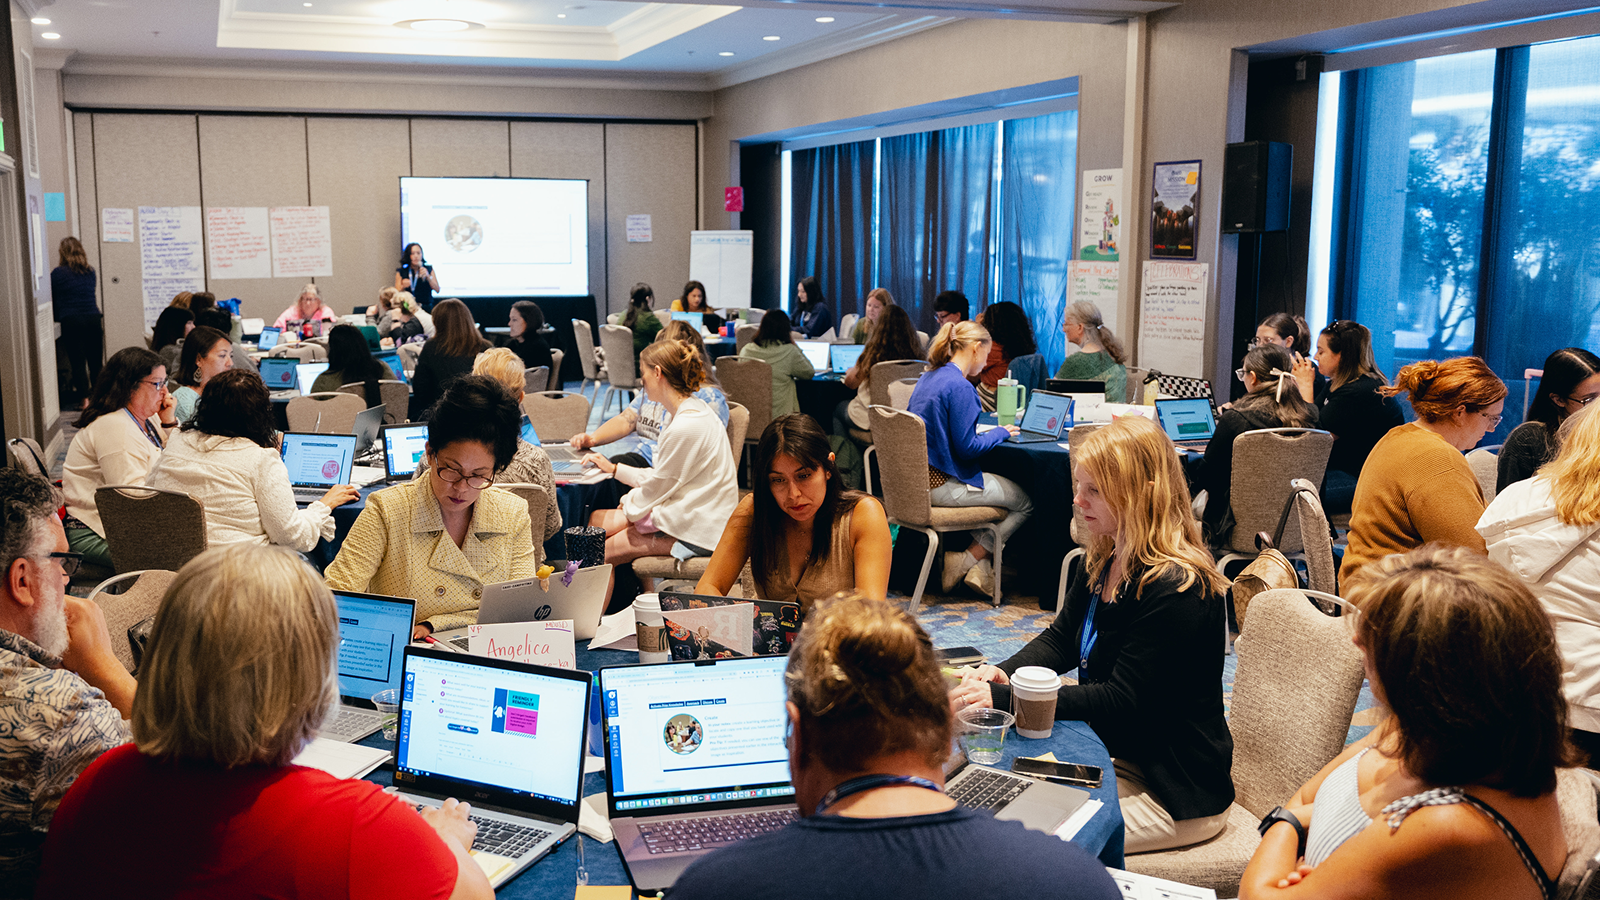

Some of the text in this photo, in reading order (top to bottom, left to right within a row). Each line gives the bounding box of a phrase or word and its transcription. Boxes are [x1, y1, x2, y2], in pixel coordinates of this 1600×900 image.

[1152, 264, 1199, 280] CELEBRATIONS
[536, 605, 550, 620] hp
[470, 626, 482, 634] VP
[487, 633, 550, 661] Angelica
[474, 791, 490, 799] acer
